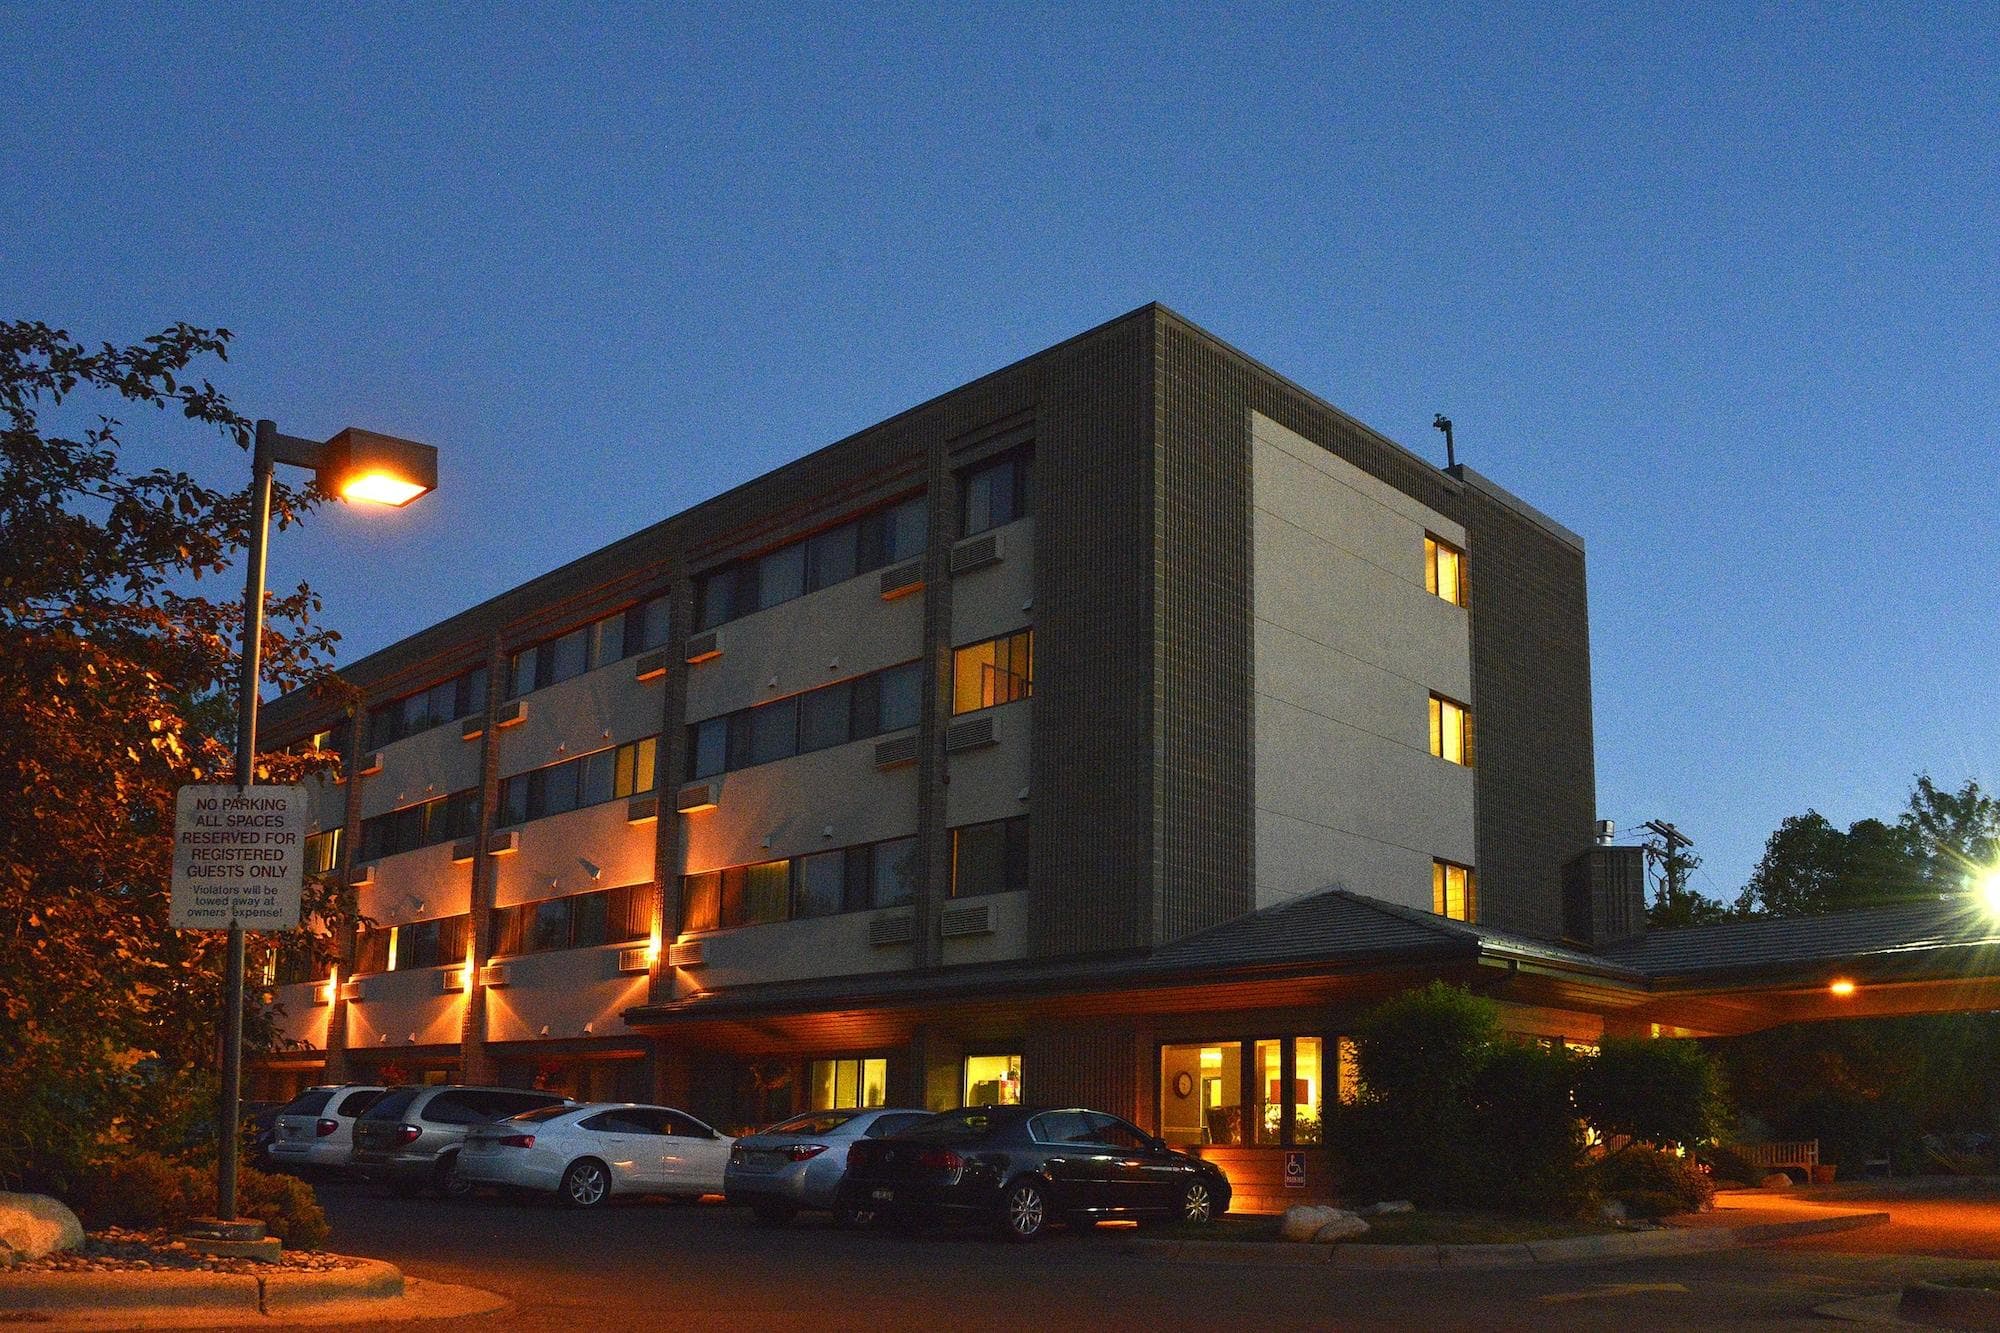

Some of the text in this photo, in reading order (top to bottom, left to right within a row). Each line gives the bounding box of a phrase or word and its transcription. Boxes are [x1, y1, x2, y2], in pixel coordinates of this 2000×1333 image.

[196, 798, 287, 811] NO PARKING
[195, 815, 284, 828] ALL SPACES
[182, 832, 296, 844] RESERVED FOR
[191, 848, 284, 861] REGISTERED
[187, 865, 288, 878] GUESTS ONLY
[193, 885, 278, 895] Violators will be
[195, 897, 275, 908] towed away at
[232, 908, 283, 918] expense!
